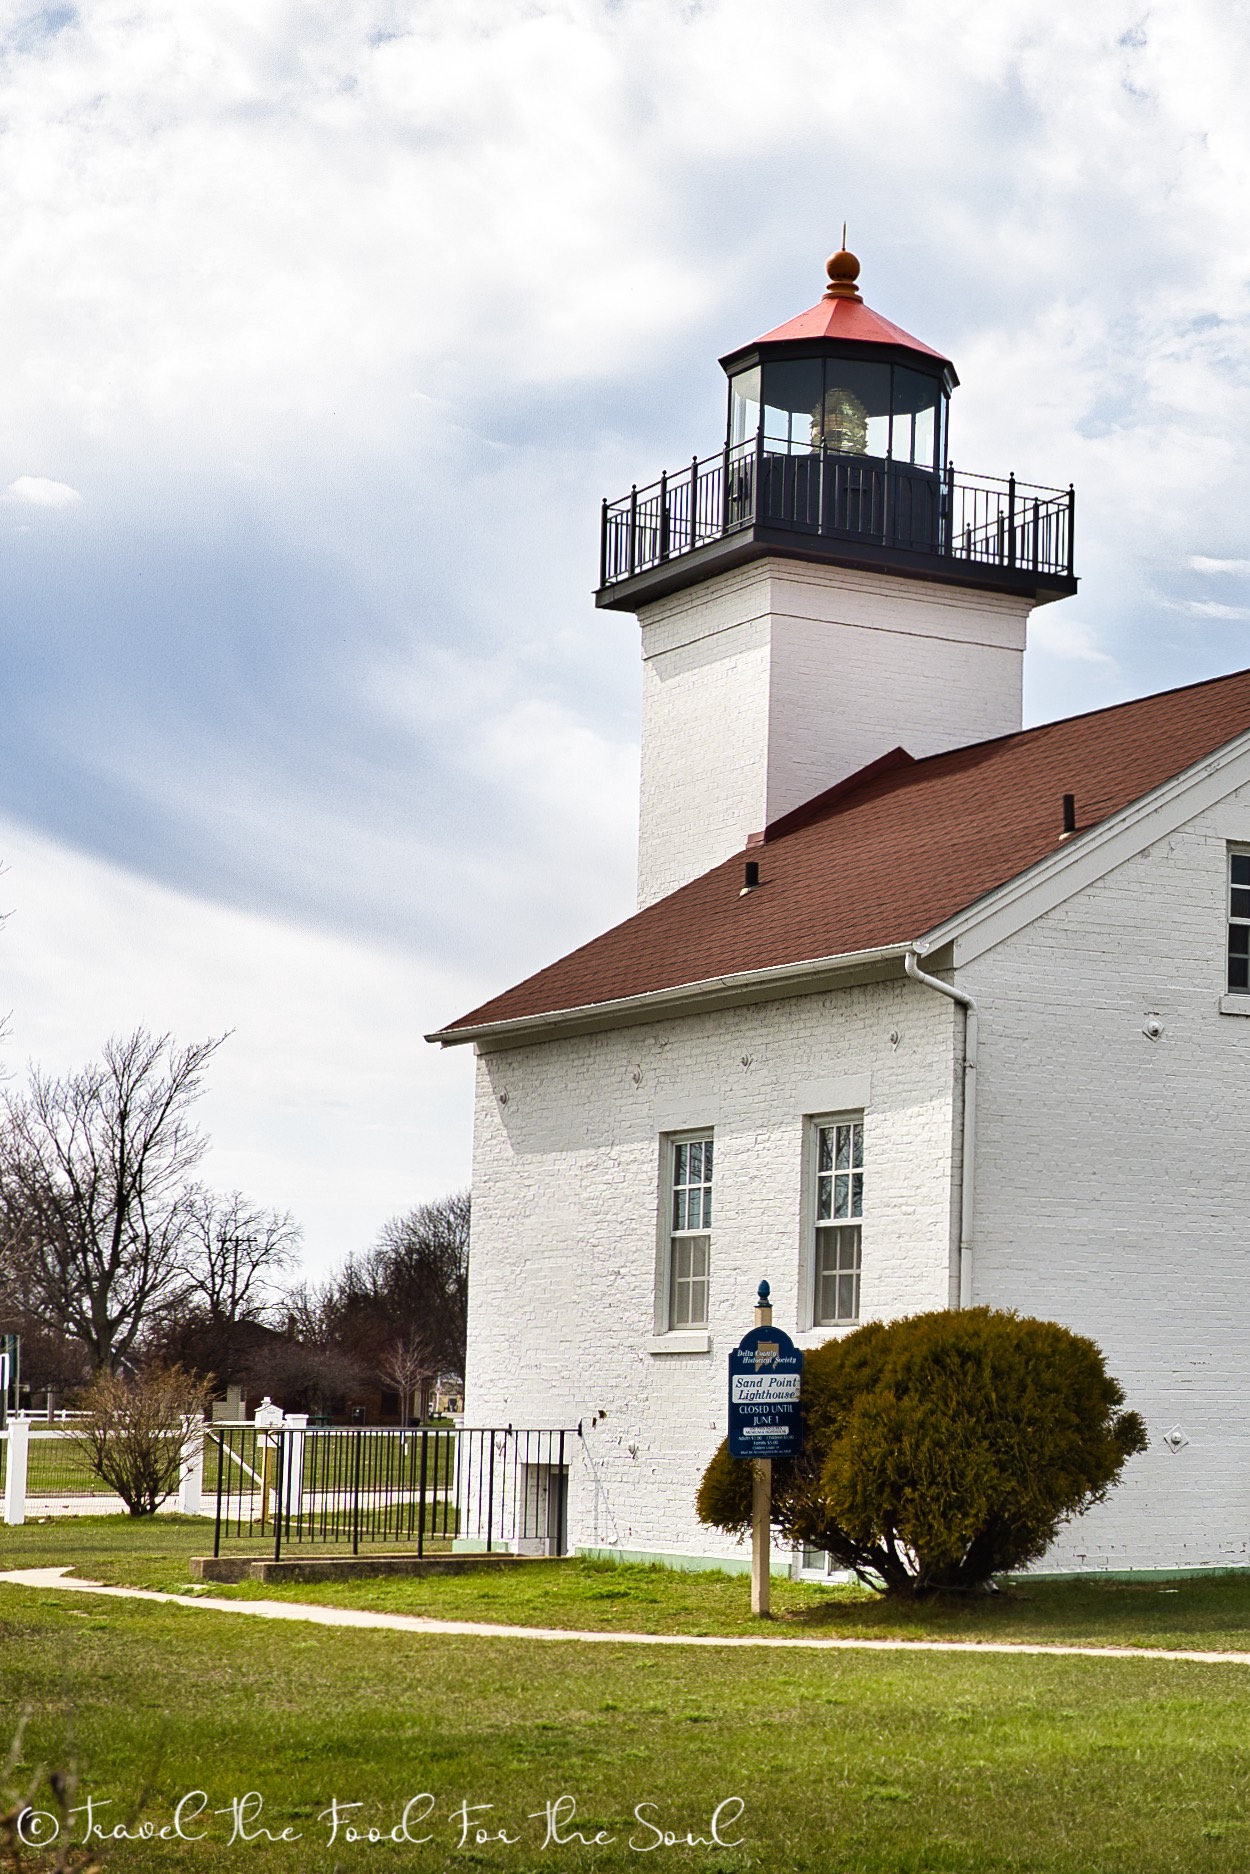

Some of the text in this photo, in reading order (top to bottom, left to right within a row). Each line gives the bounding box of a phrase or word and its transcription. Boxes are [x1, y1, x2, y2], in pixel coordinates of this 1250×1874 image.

[737, 1349, 777, 1358] Delta County
[742, 1356, 796, 1364] Historical Society
[736, 1378, 796, 1388] Sand Point
[738, 1390, 795, 1401] Lighthouse
[739, 1404, 794, 1414] CLOSED UNTIL
[753, 1415, 779, 1426] JUNE 1
